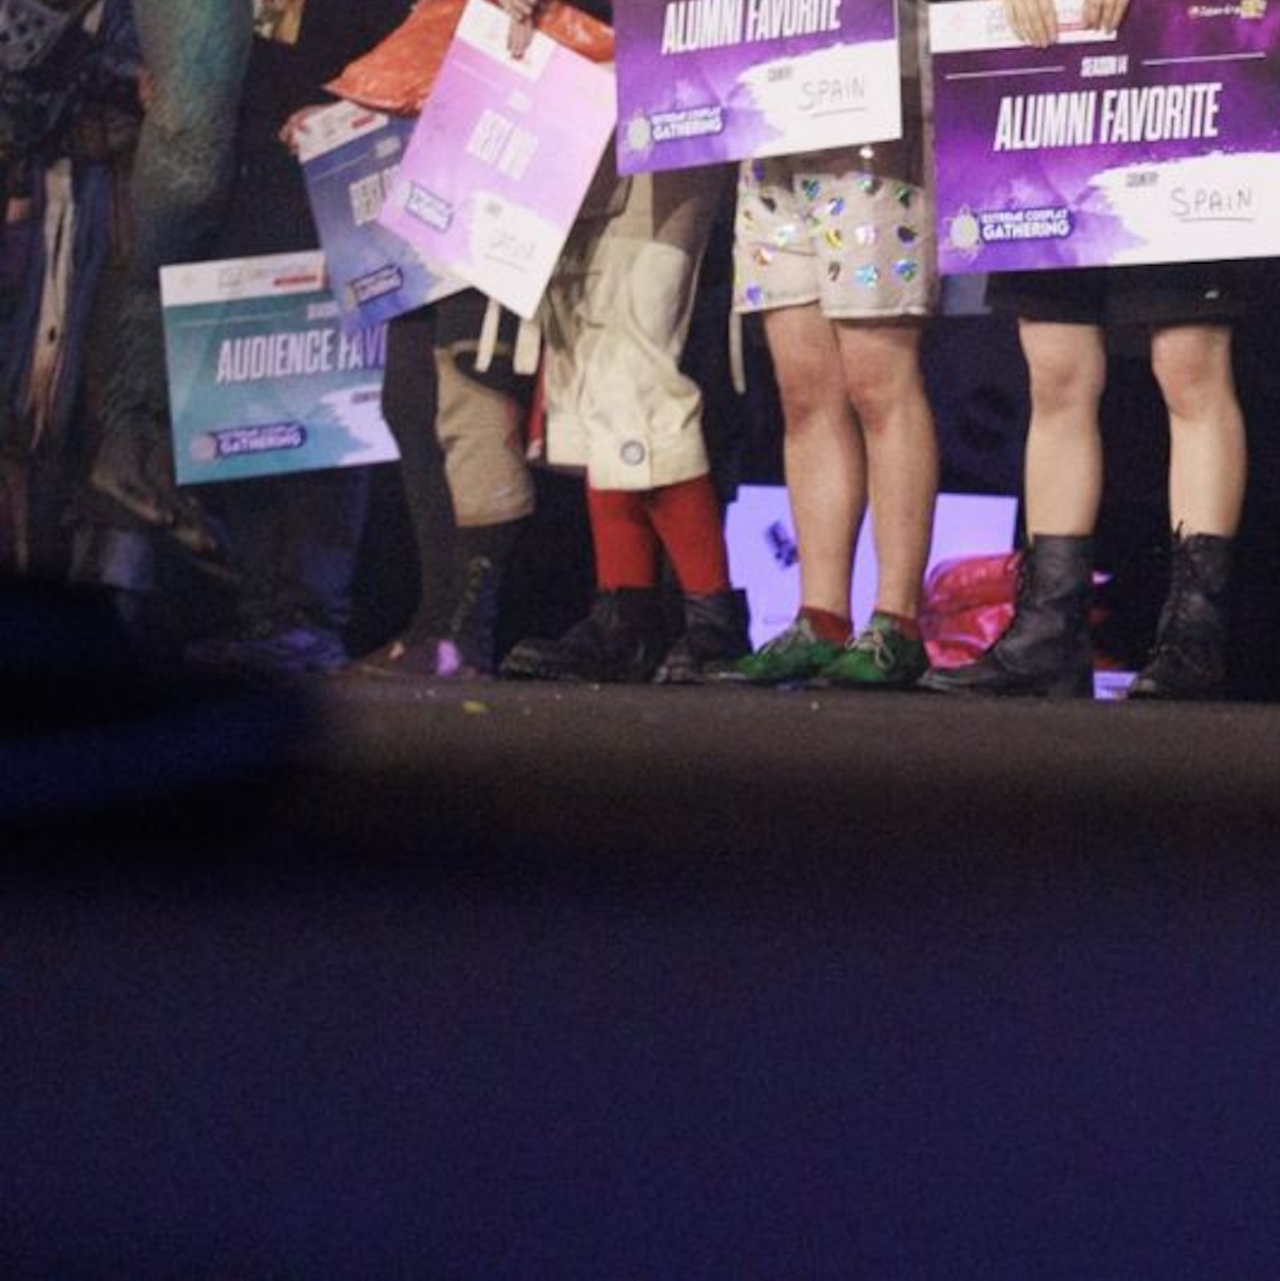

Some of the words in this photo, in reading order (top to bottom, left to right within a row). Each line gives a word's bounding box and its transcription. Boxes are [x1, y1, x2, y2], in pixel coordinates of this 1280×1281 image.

[796, 74, 867, 111] SPAIN
[992, 90, 1097, 153] ALUMNI
[1097, 81, 1223, 145] FAVORITE
[1169, 186, 1253, 218] SPAIN
[983, 221, 1071, 242] GATHERING
[216, 329, 335, 384] AUDIENCE
